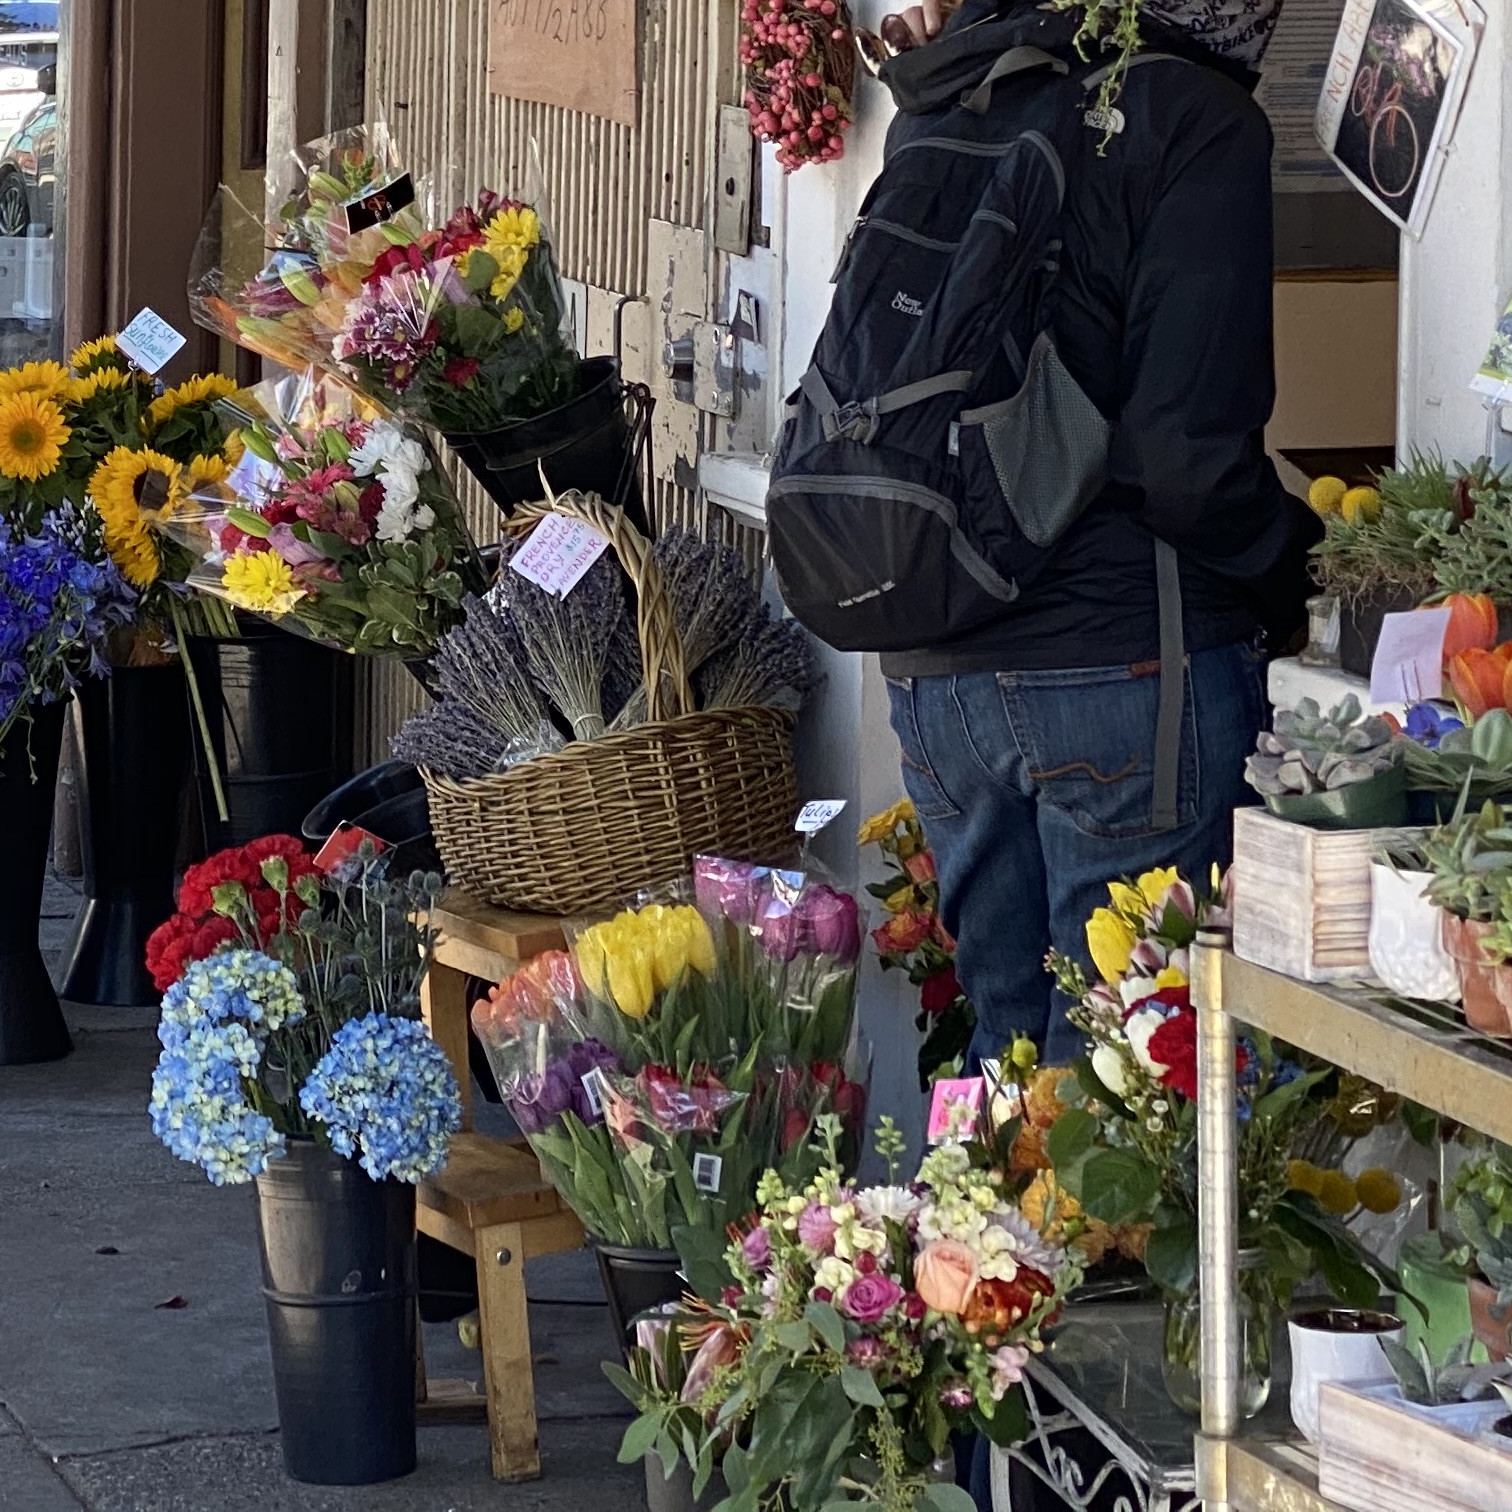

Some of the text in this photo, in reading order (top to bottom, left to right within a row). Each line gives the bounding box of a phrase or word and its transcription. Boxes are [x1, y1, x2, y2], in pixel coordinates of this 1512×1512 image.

[138, 311, 177, 344] FRESH
[520, 518, 559, 568] FRENCH
[540, 554, 565, 583] DRY
